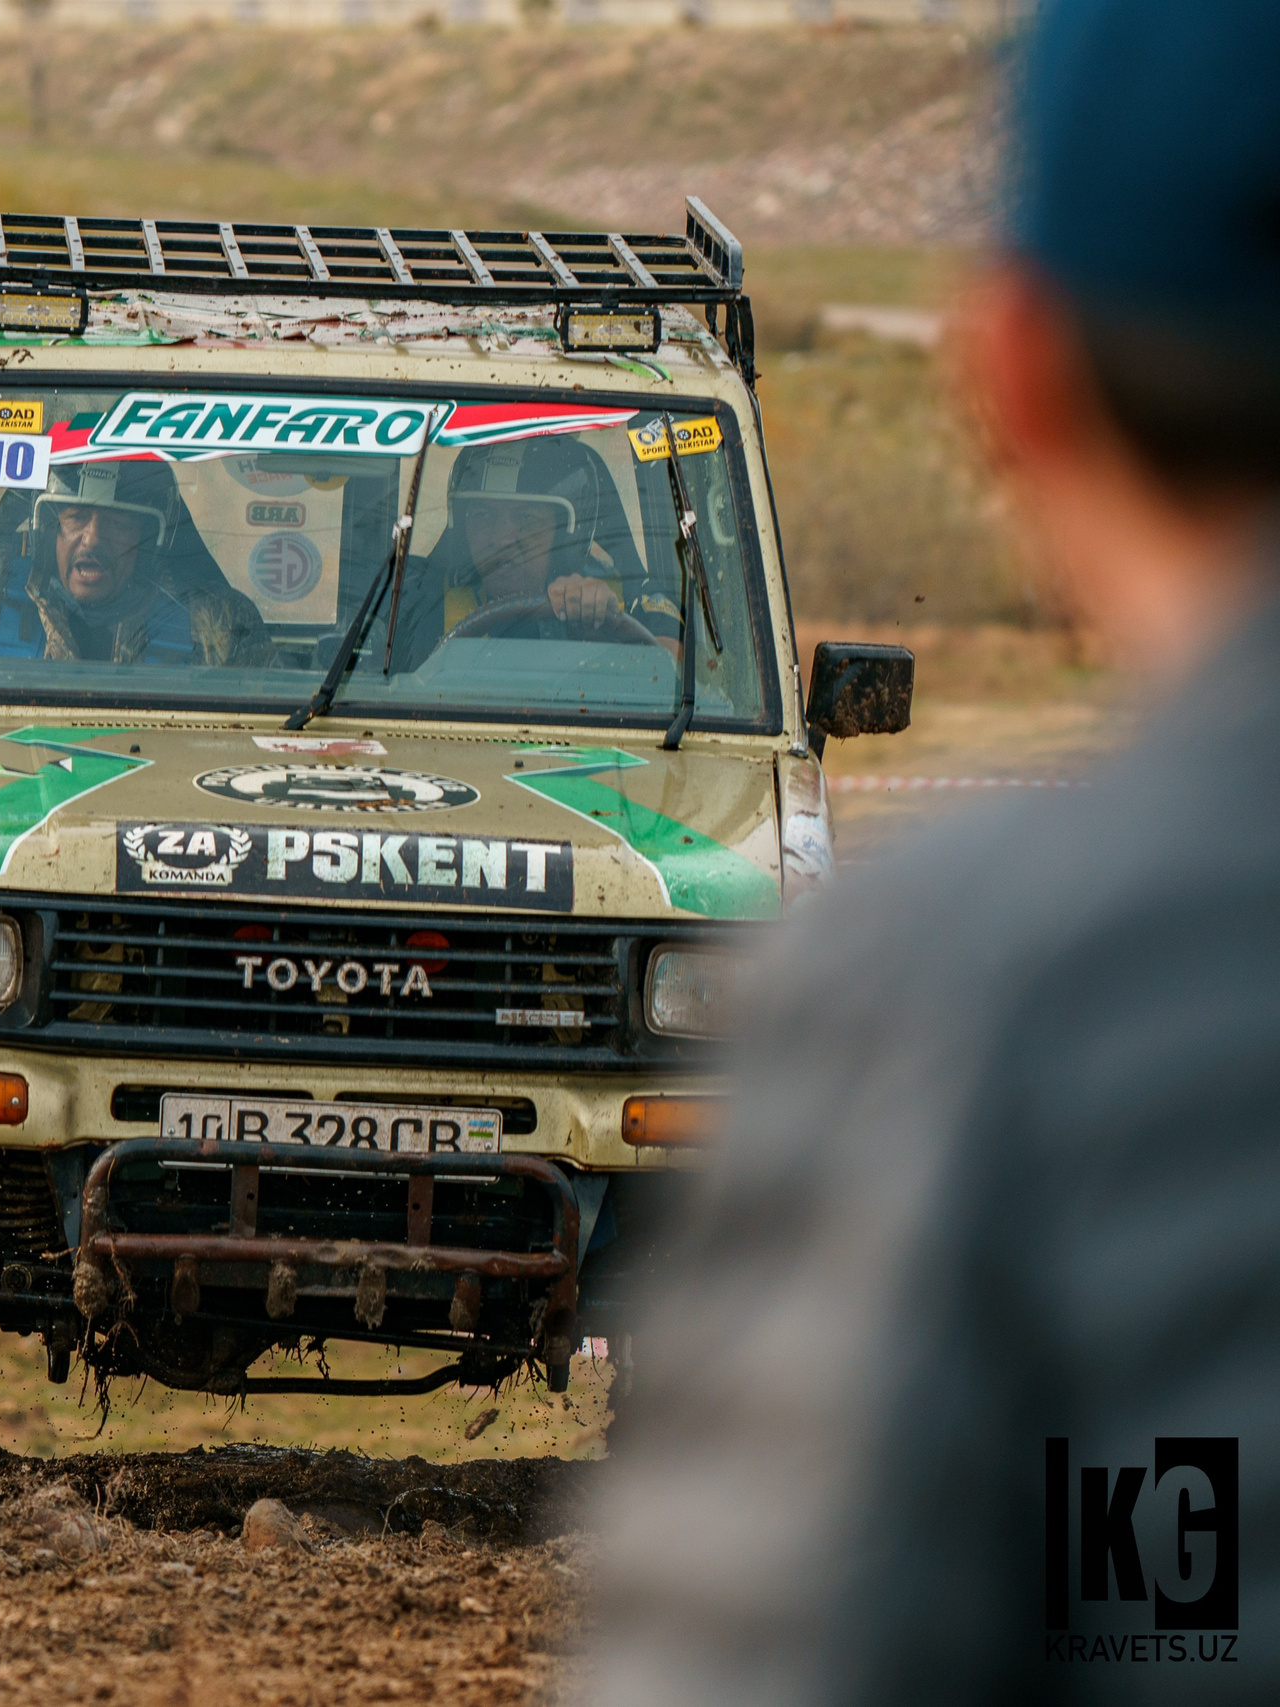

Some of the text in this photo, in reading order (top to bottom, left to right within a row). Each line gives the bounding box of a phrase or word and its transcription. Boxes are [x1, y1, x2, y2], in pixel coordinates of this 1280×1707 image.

[111, 400, 425, 446] FANFARO
[642, 445, 667, 456] SPORT
[157, 831, 217, 856] ZA
[149, 869, 226, 882] KOMANDA
[267, 829, 561, 893] PSKENT
[236, 956, 433, 998] TOYOTA
